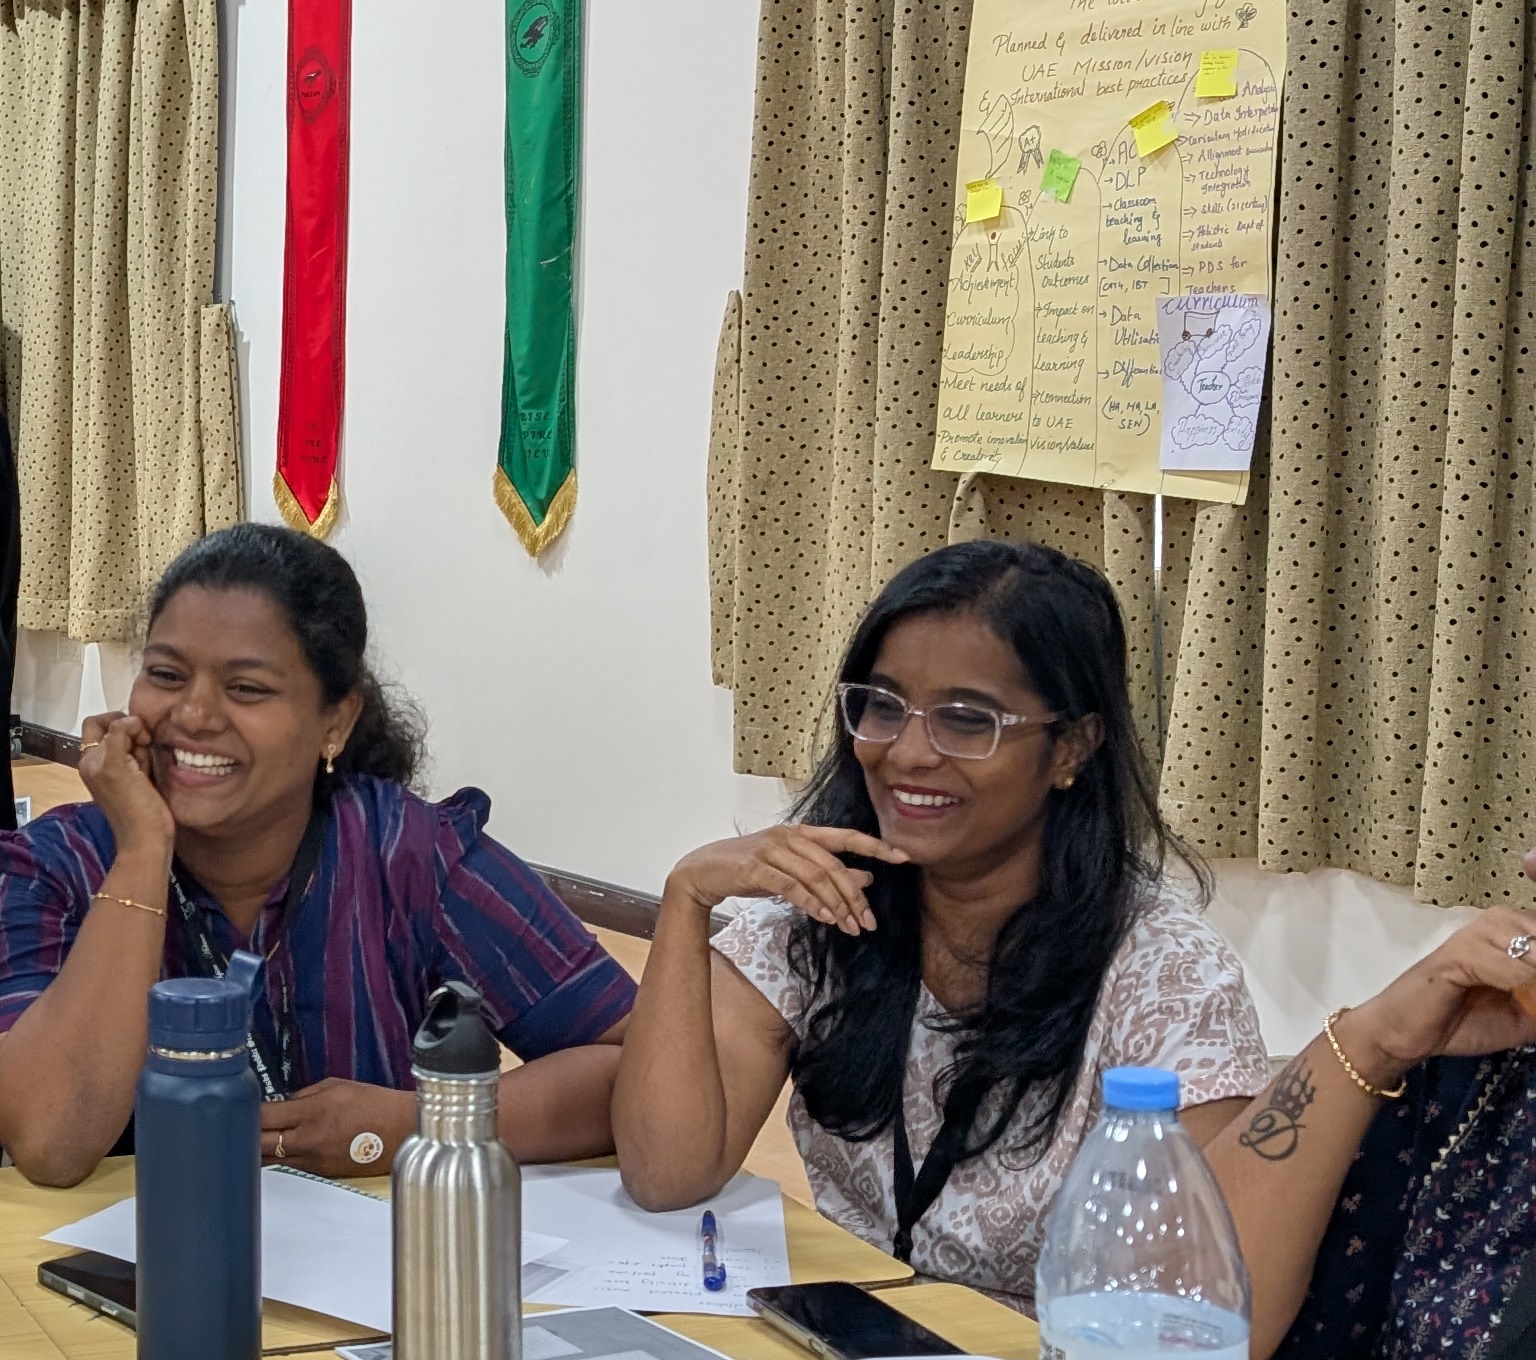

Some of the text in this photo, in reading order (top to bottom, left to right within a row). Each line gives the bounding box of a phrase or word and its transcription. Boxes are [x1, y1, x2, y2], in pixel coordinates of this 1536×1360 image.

[992, 30, 1048, 57] Planned
[1080, 19, 1143, 44] delivered
[1152, 14, 1167, 36] in
[1172, 17, 1194, 38] line
[1200, 13, 1232, 34] with
[1022, 62, 1059, 83] UAE
[1010, 77, 1086, 107] International
[1096, 78, 1123, 96] best
[1204, 107, 1232, 126] Data
[1118, 140, 1137, 165] AC
[1115, 166, 1147, 191] DLP
[1059, 223, 1069, 241] to
[1105, 212, 1144, 232] teaching
[1122, 229, 1163, 248] learning
[1035, 250, 1076, 271] Students
[1108, 254, 1180, 273] Data Collection
[1199, 255, 1248, 275] PDS for
[1185, 280, 1237, 296] Teachers
[1041, 300, 1095, 330] Impact on
[1110, 304, 1142, 327] Data
[1035, 328, 1079, 353] teaching
[942, 343, 1004, 370] Leadership
[980, 376, 1012, 392] needs
[1015, 375, 1028, 404] of
[1197, 374, 1224, 394] Teacher
[942, 403, 1024, 422] all learners
[1031, 414, 1074, 430] to UAE
[939, 429, 983, 447] Promote
